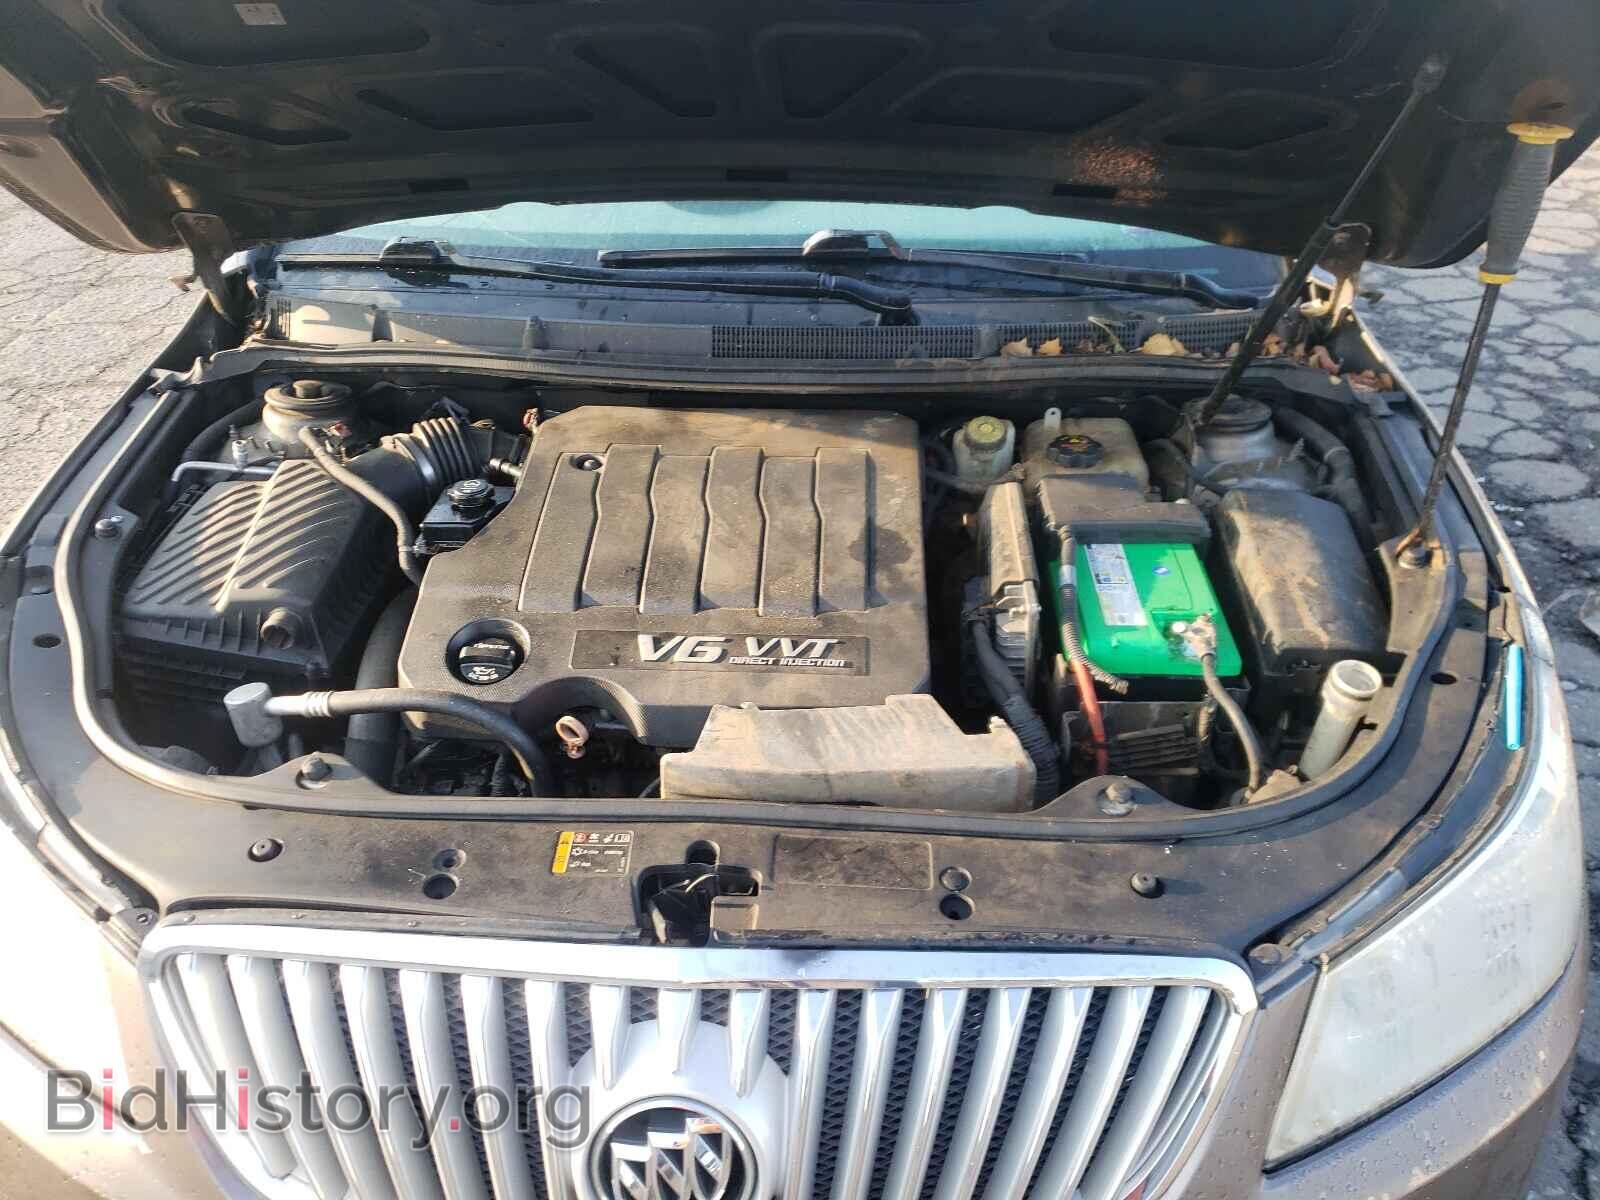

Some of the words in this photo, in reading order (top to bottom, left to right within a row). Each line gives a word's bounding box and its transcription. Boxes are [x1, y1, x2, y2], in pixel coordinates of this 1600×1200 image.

[637, 634, 727, 663] V6
[745, 636, 840, 659] VVT
[729, 656, 777, 667] DIRECT
[780, 657, 846, 668] INJECTION
